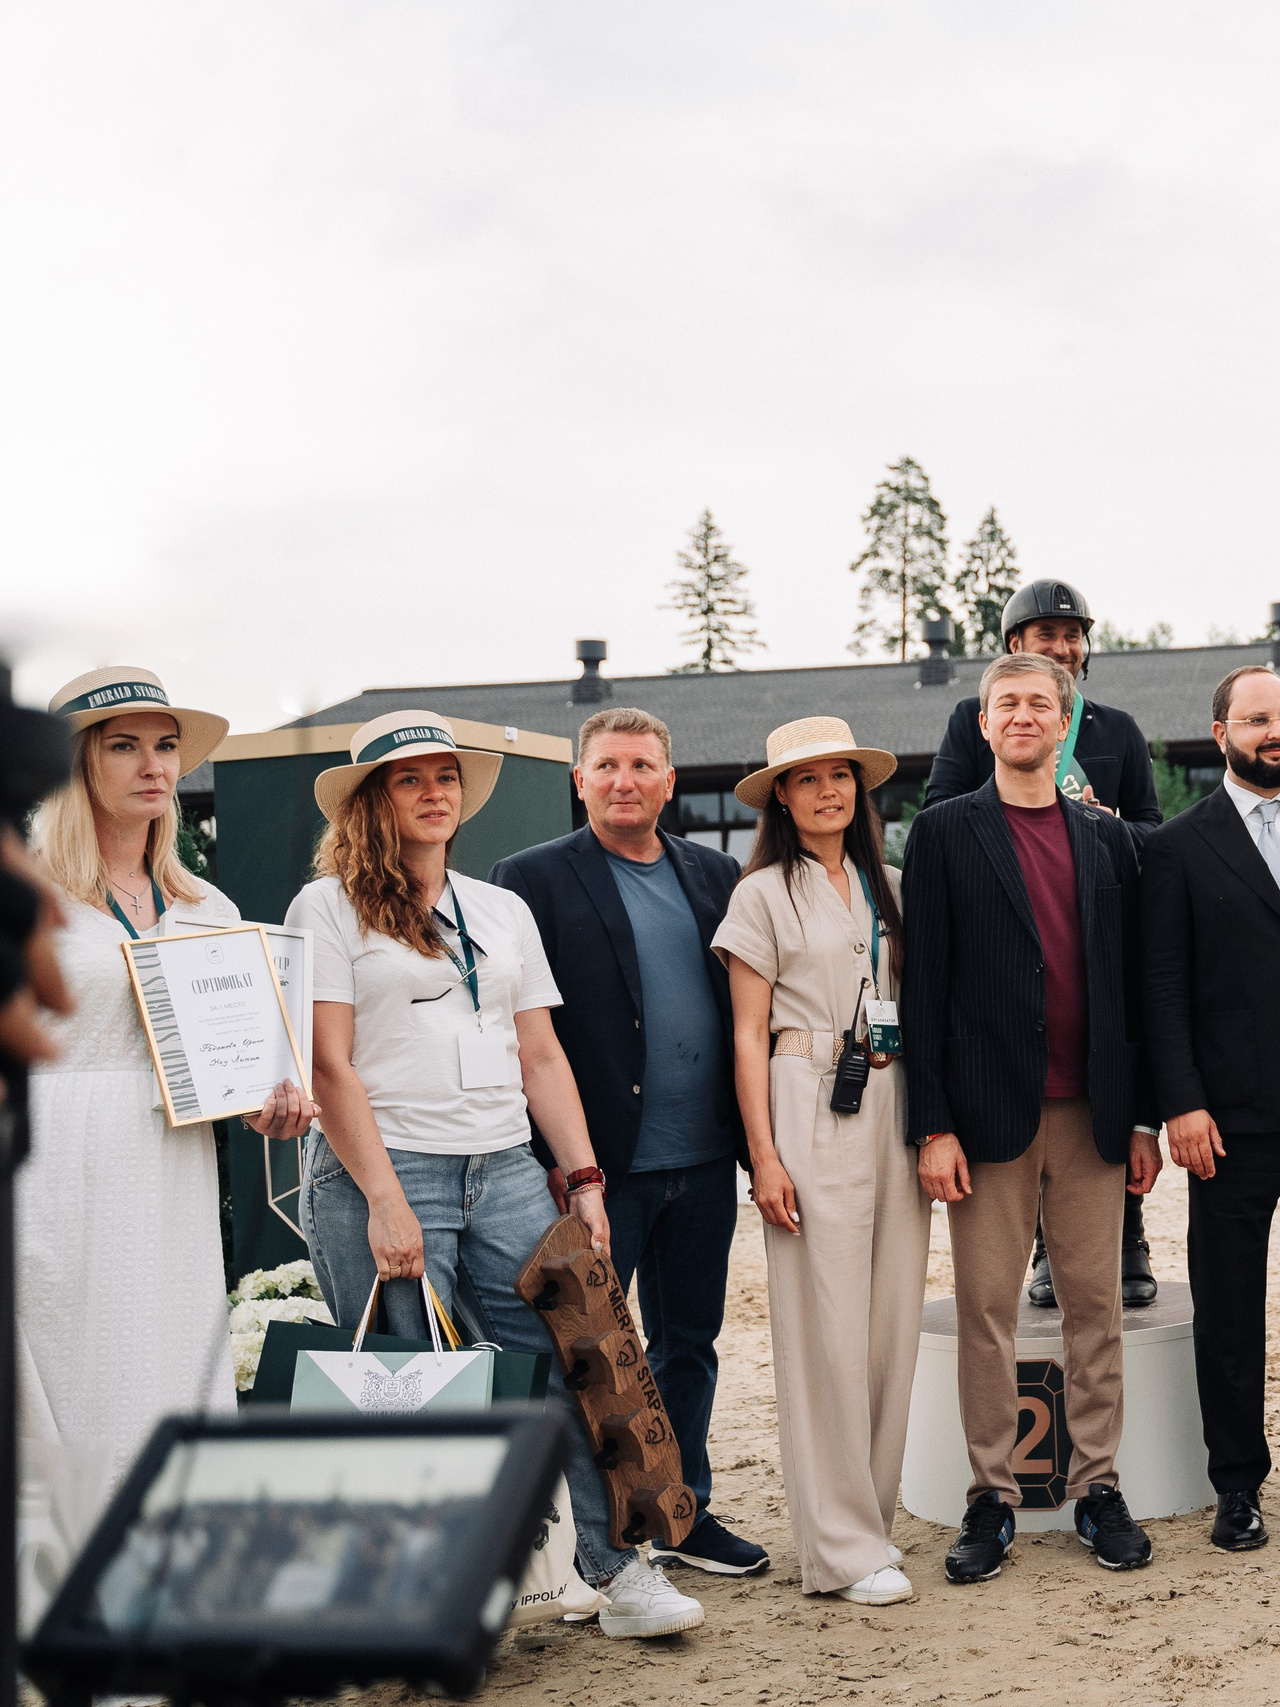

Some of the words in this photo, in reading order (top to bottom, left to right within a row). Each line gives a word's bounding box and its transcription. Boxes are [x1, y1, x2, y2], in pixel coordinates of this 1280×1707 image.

[87, 686, 131, 708] EMERALD
[392, 728, 432, 744] EMERALD
[191, 972, 253, 995] СЕРТИФИКАТ
[223, 1001, 246, 1010] МЕСТО
[1011, 1396, 1053, 1474] 2
